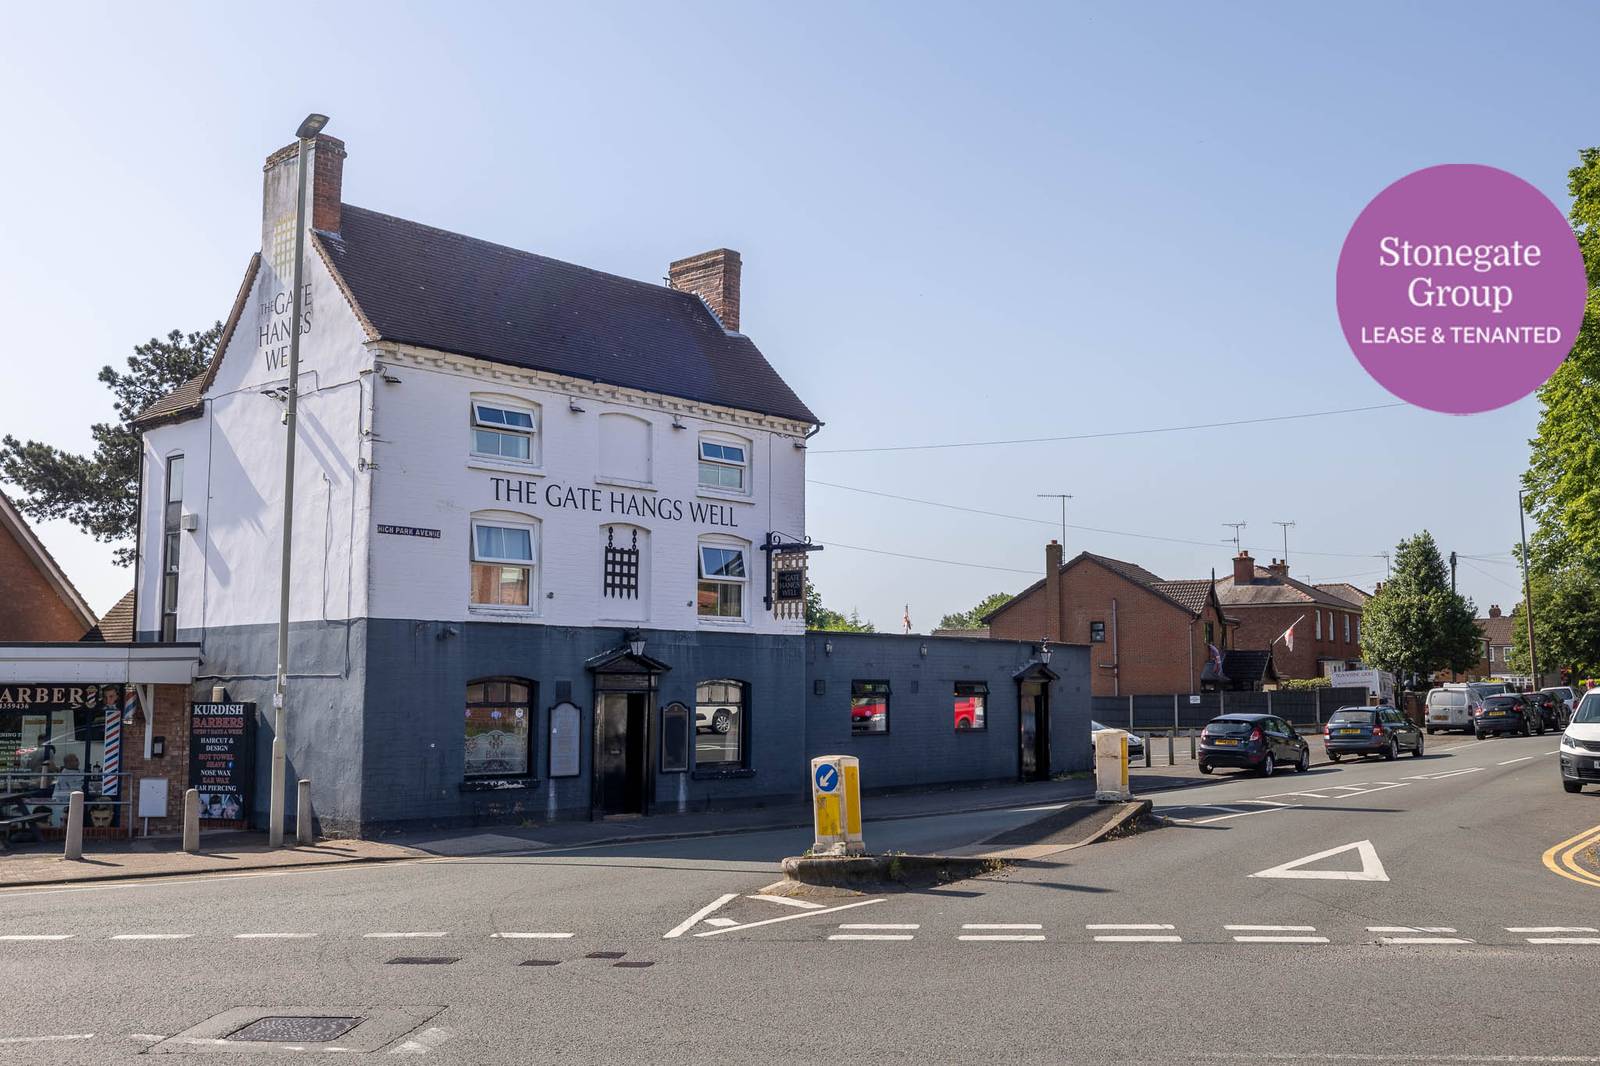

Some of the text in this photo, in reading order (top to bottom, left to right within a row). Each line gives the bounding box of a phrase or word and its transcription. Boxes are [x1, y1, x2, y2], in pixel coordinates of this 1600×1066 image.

[261, 283, 312, 315] THE GAE
[490, 477, 738, 527] THE GATE HANGS WELL
[377, 525, 440, 538] HIGH PARK AVENUE
[193, 704, 244, 715] KURDISH
[192, 717, 244, 728] BARBERS
